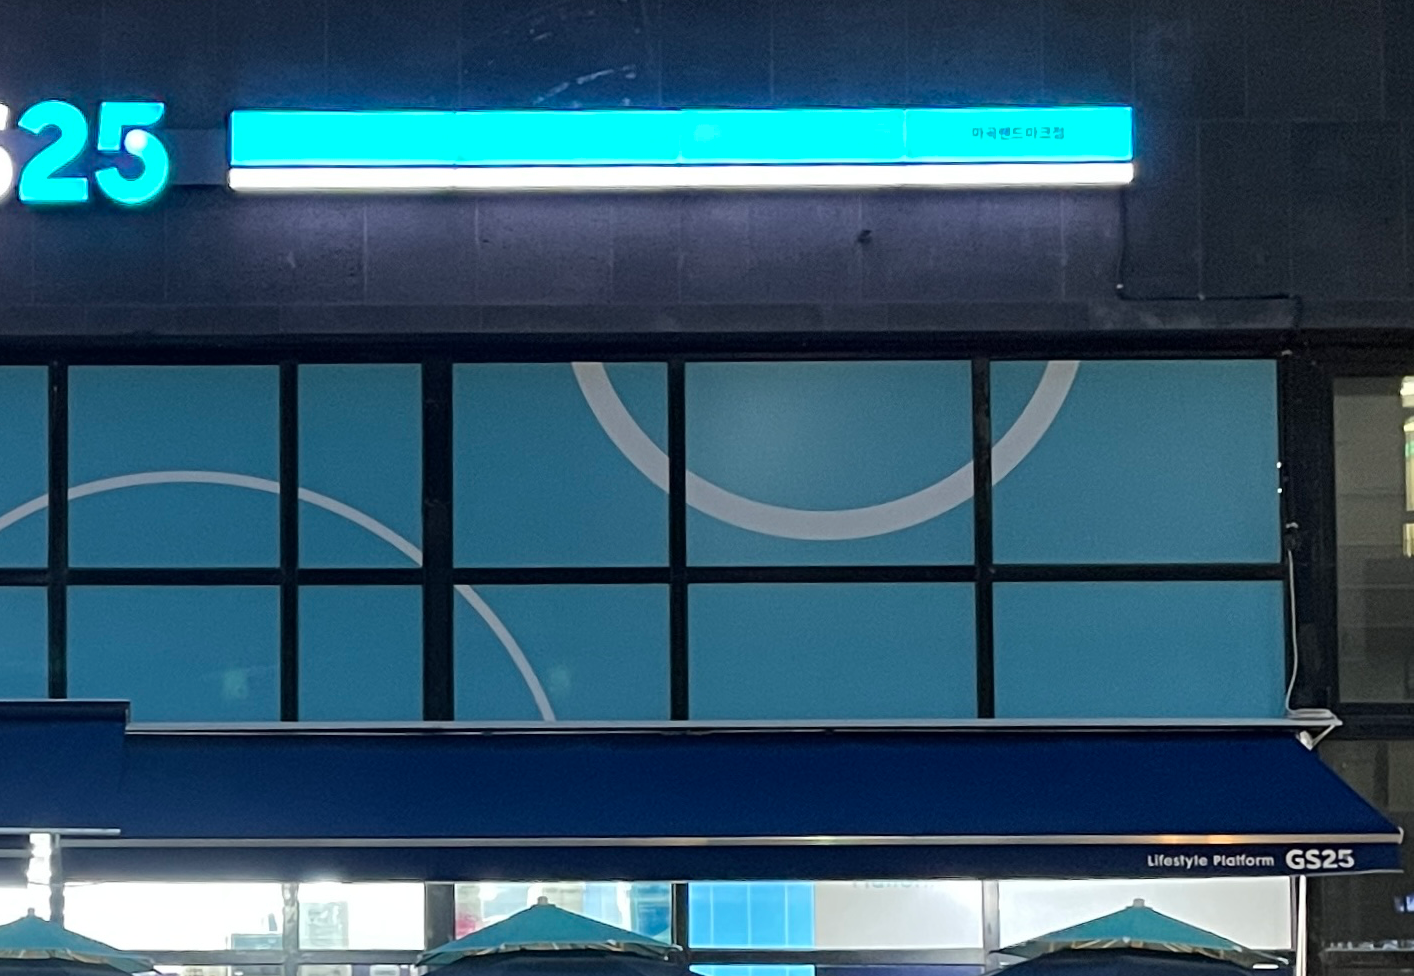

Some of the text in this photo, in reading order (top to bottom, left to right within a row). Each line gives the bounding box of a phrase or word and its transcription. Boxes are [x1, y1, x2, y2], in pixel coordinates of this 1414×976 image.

[1147, 849, 1355, 870] Lifestyle Platform GS25
